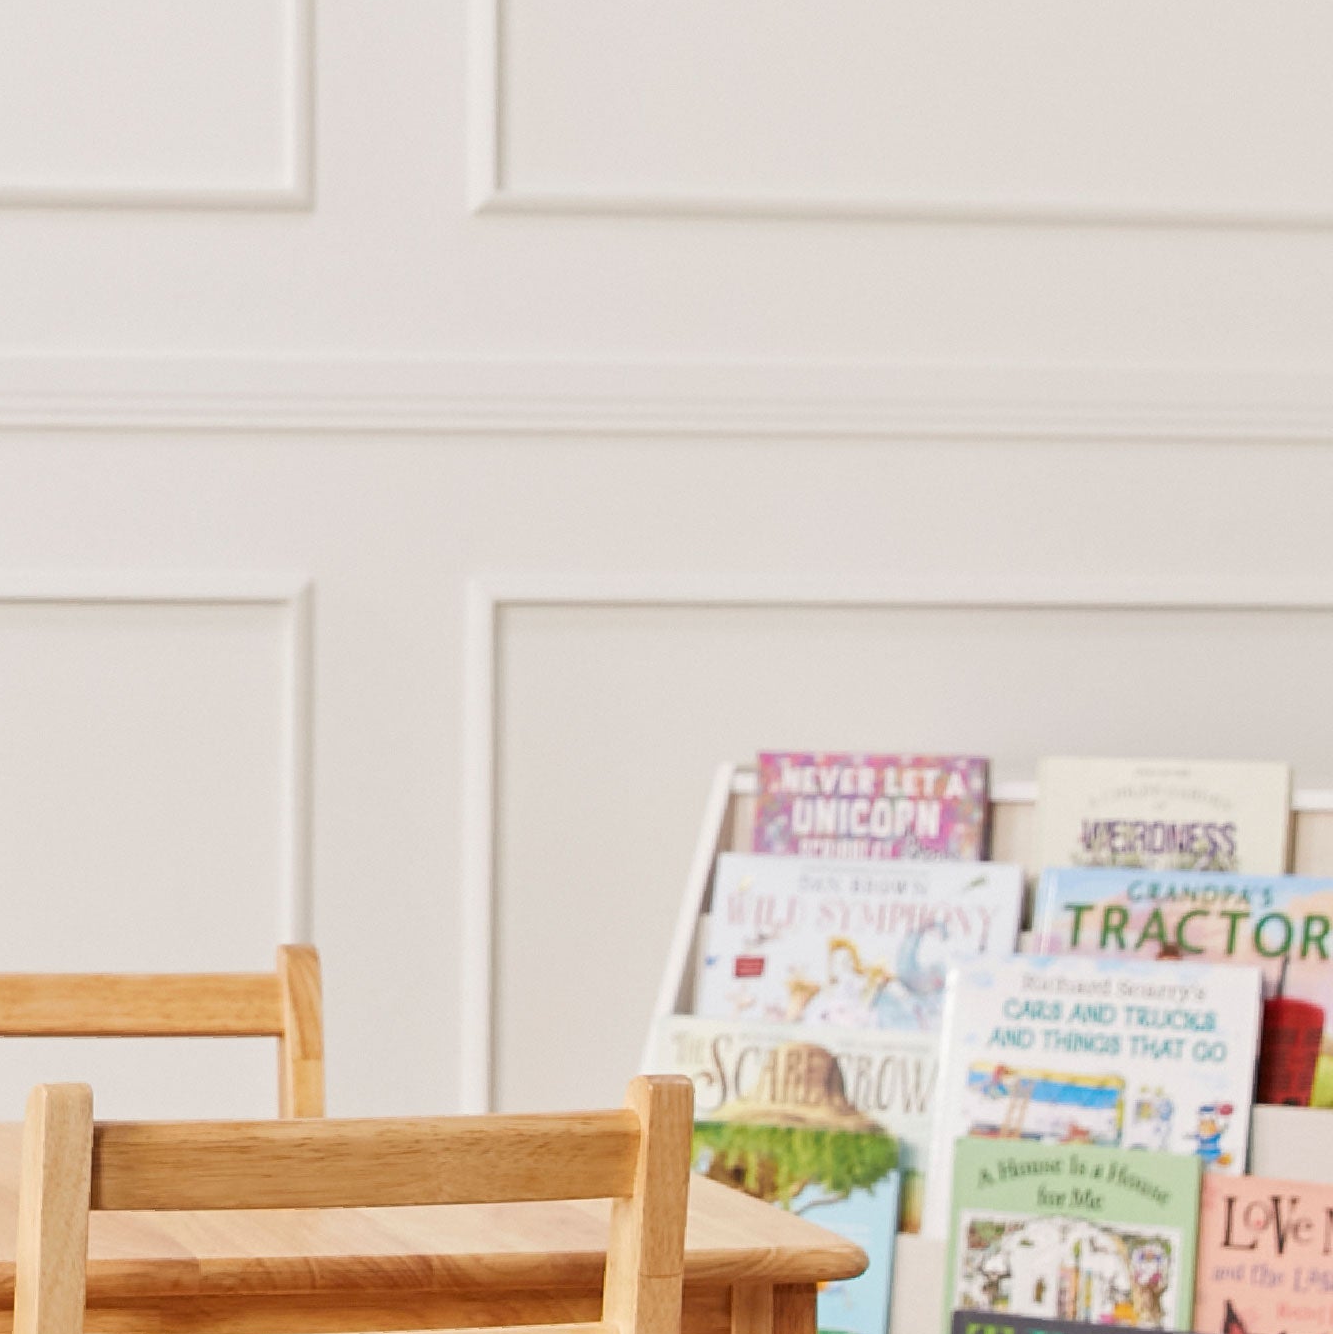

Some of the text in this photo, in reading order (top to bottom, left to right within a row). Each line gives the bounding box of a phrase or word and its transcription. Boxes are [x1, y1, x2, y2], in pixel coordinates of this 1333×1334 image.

[782, 757, 968, 798] NEVER LET A
[1127, 879, 1274, 908] GRANDPA'S
[1064, 902, 1332, 959] TRACTOR
[1002, 997, 1218, 1033] CARS AND TRUCKS
[987, 1026, 1229, 1063] AND THINGS THAT GO
